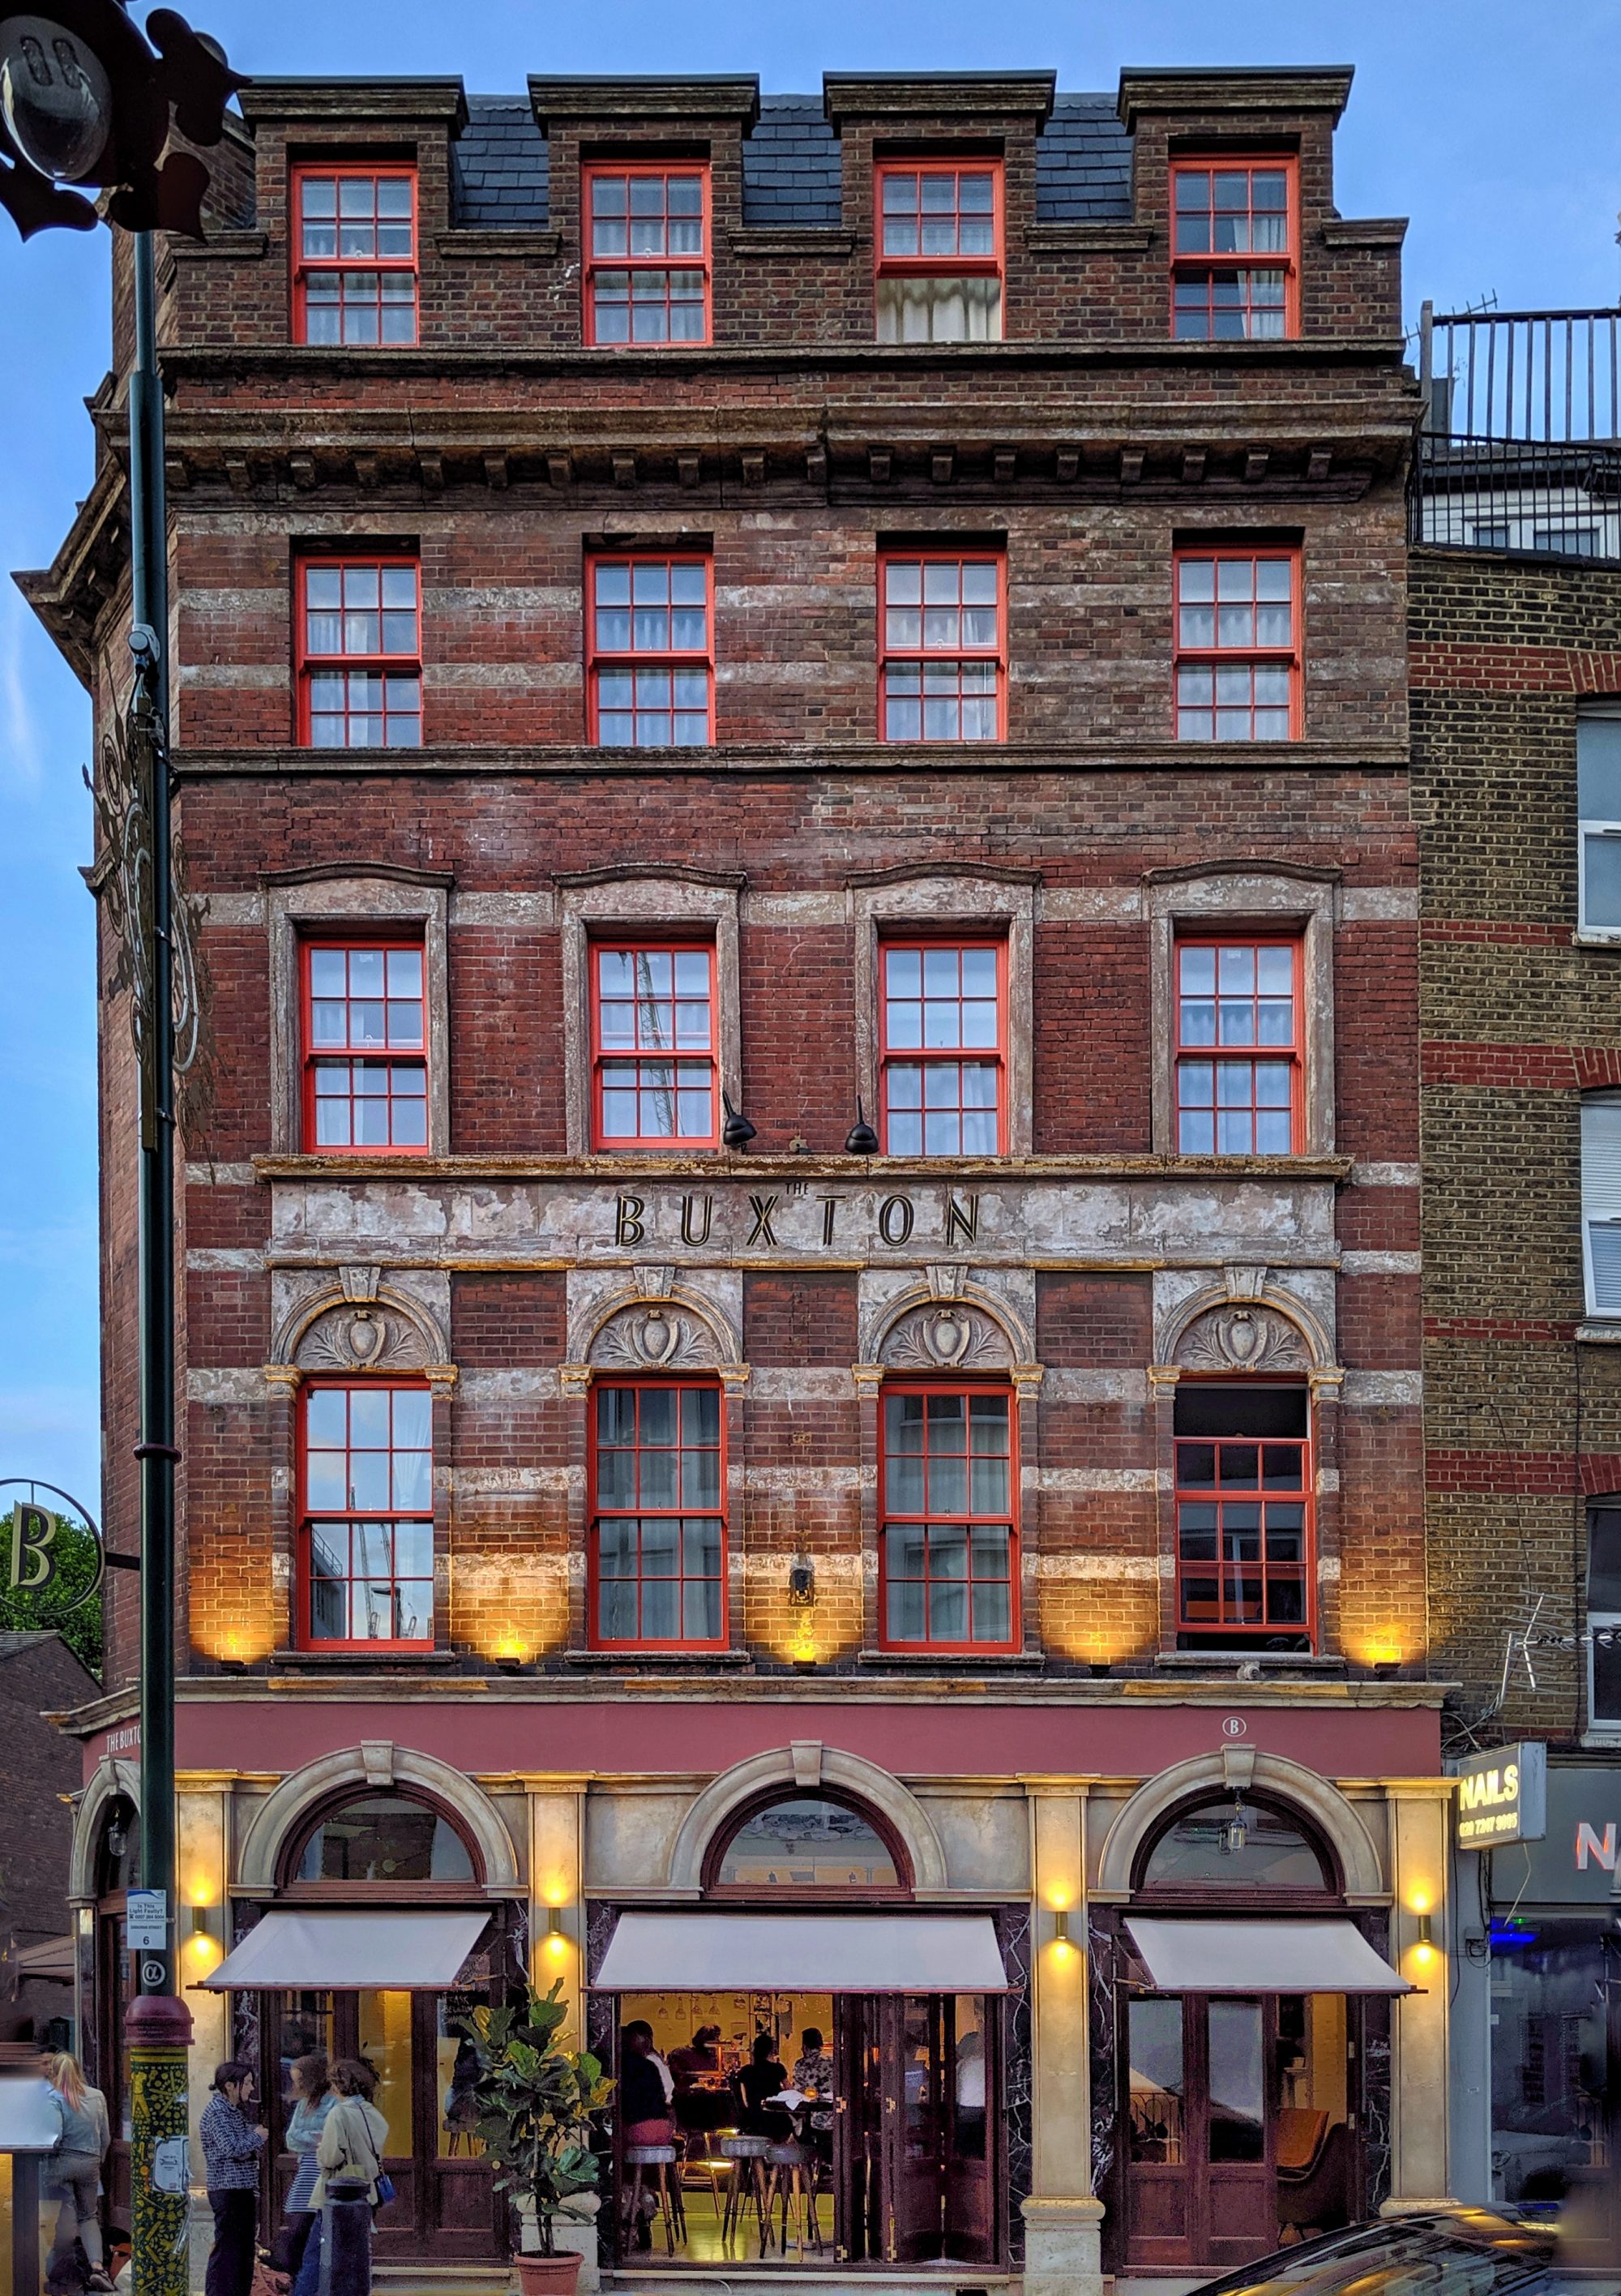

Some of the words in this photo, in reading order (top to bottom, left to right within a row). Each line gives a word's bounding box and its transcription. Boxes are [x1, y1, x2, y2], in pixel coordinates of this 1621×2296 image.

[785, 1181, 809, 1195] THE
[615, 1194, 979, 1247] BUXTON
[11, 1499, 57, 1591] B
[106, 1732, 118, 1754] THE
[120, 1724, 141, 1750] BUXTO
[1230, 1719, 1239, 1734] B
[1460, 1764, 1519, 1811] NAILS
[143, 1936, 150, 1945] 6
